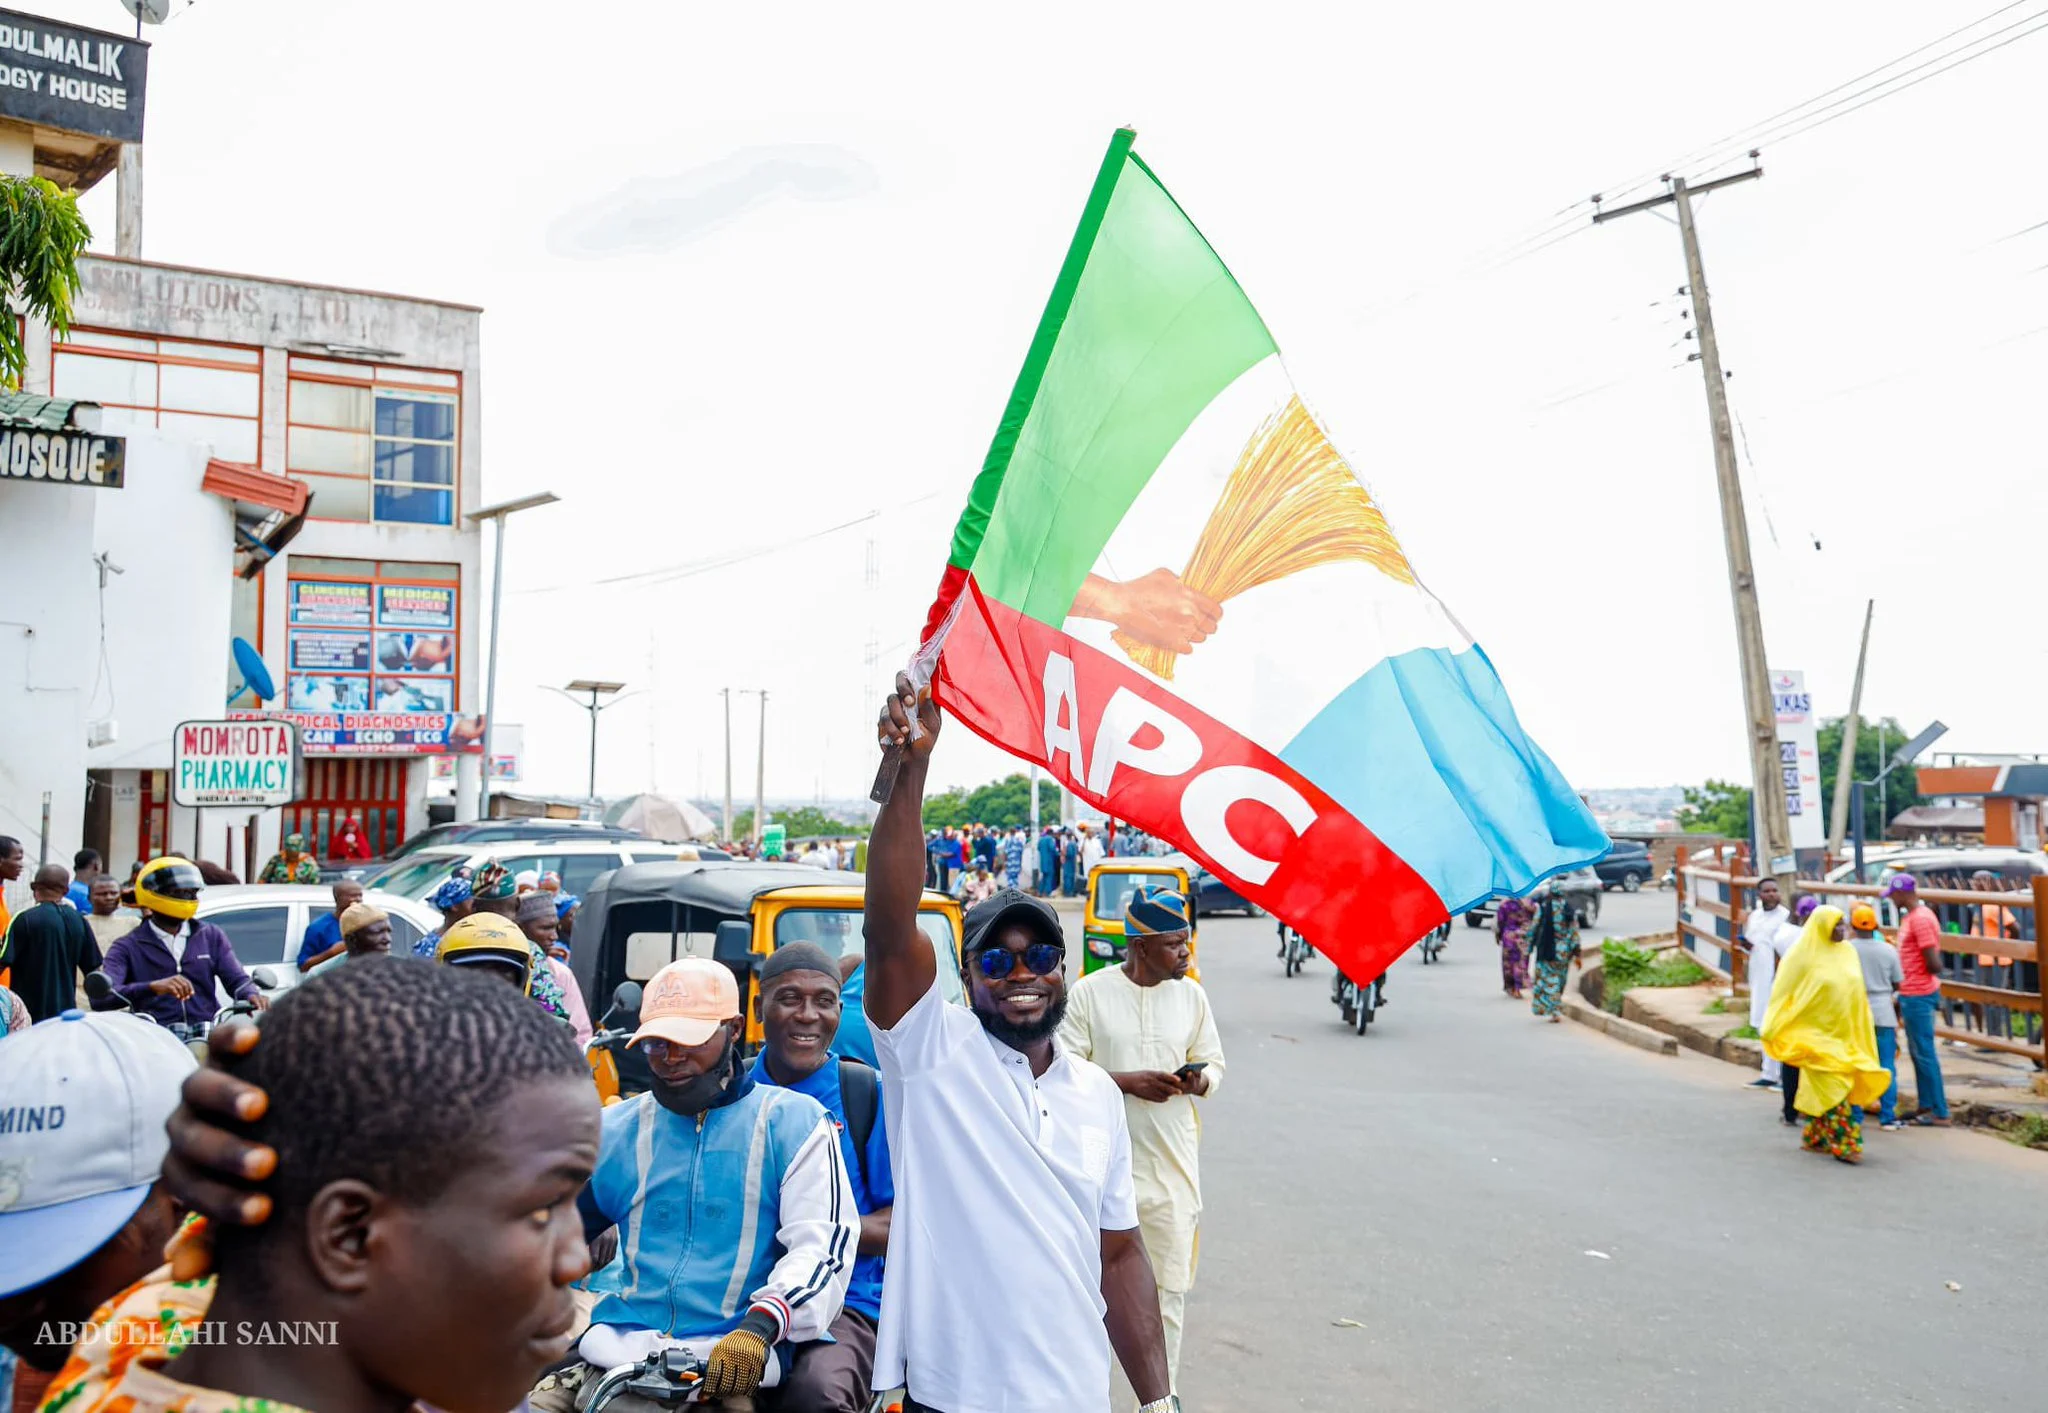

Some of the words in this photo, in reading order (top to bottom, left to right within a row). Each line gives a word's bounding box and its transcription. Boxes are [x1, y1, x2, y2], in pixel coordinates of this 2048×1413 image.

[49, 73, 127, 111] HOUSE
[343, 714, 446, 729] DIAGNOSTICS
[184, 726, 288, 755] MOMROTA
[355, 731, 394, 743] ECHO
[414, 731, 442, 743] ECG
[182, 760, 287, 789] PHARMACY
[1043, 650, 1319, 887] APC
